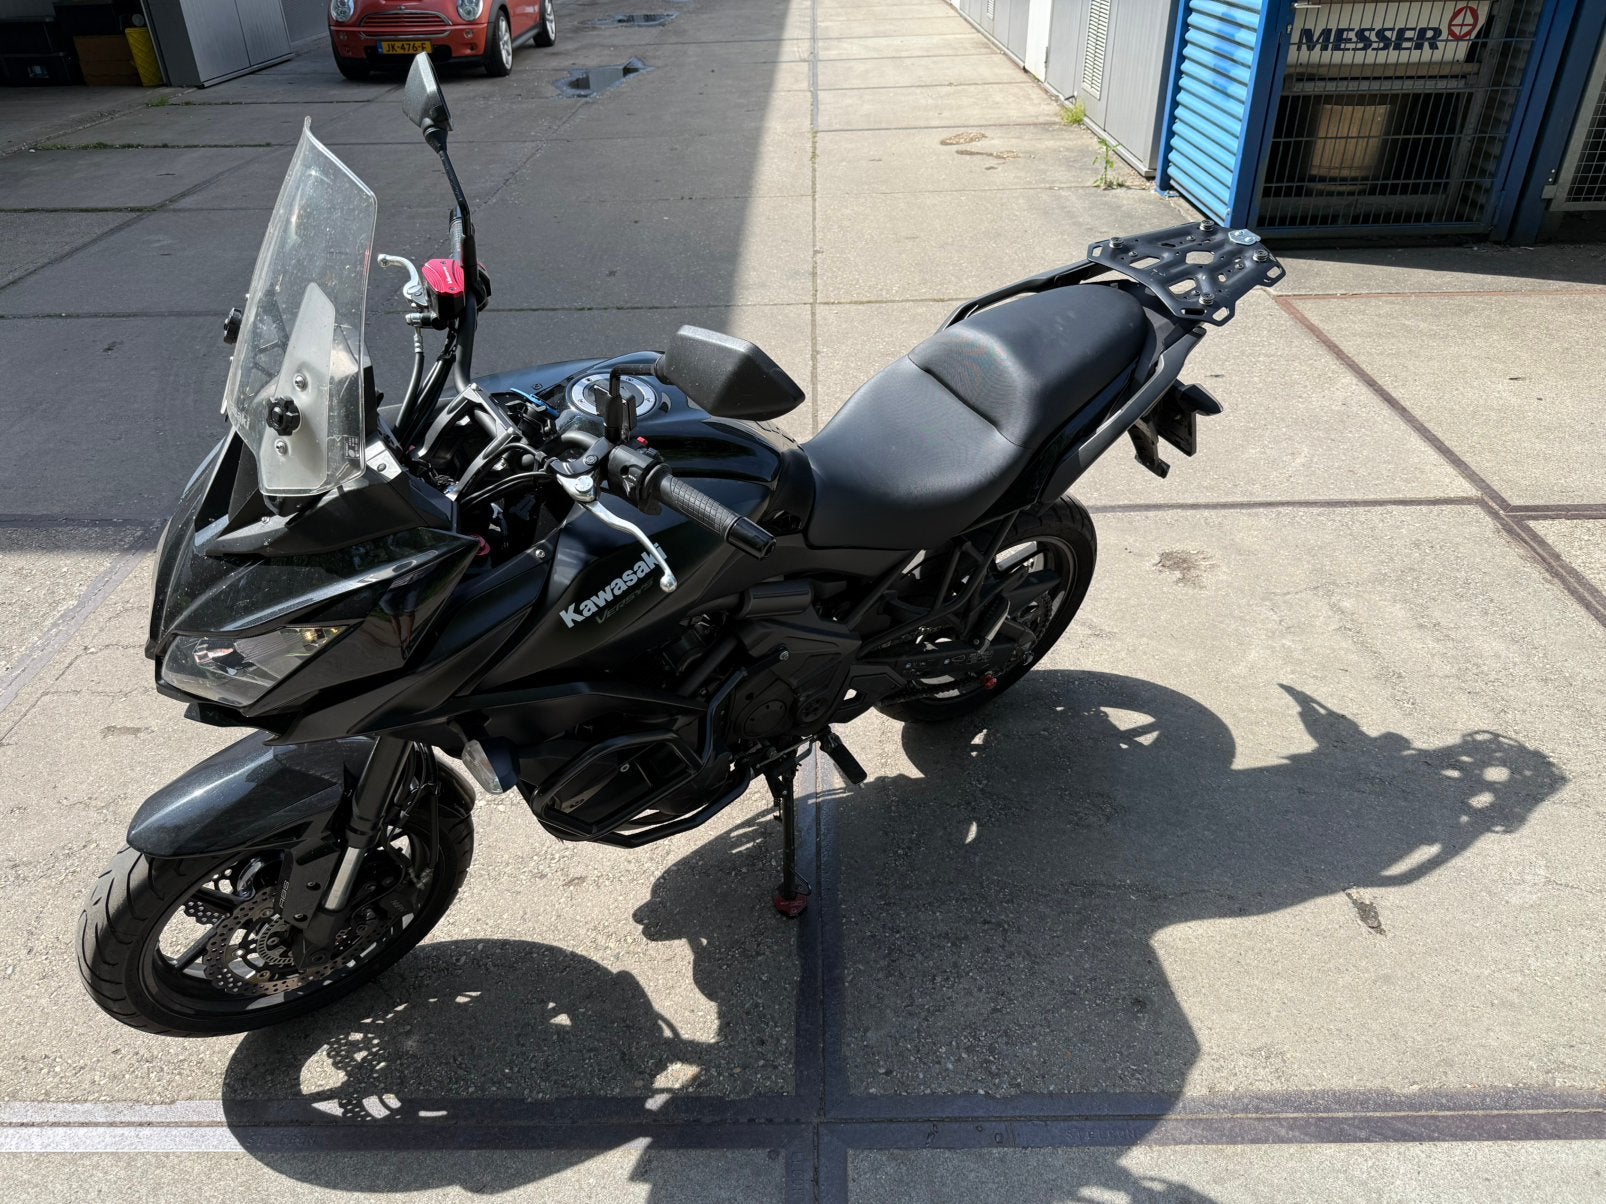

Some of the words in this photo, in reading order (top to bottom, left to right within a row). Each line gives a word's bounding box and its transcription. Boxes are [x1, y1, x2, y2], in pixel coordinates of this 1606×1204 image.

[386, 43, 427, 53] JK-476-F
[1298, 27, 1442, 51] MESSER
[279, 879, 290, 909] ABS
